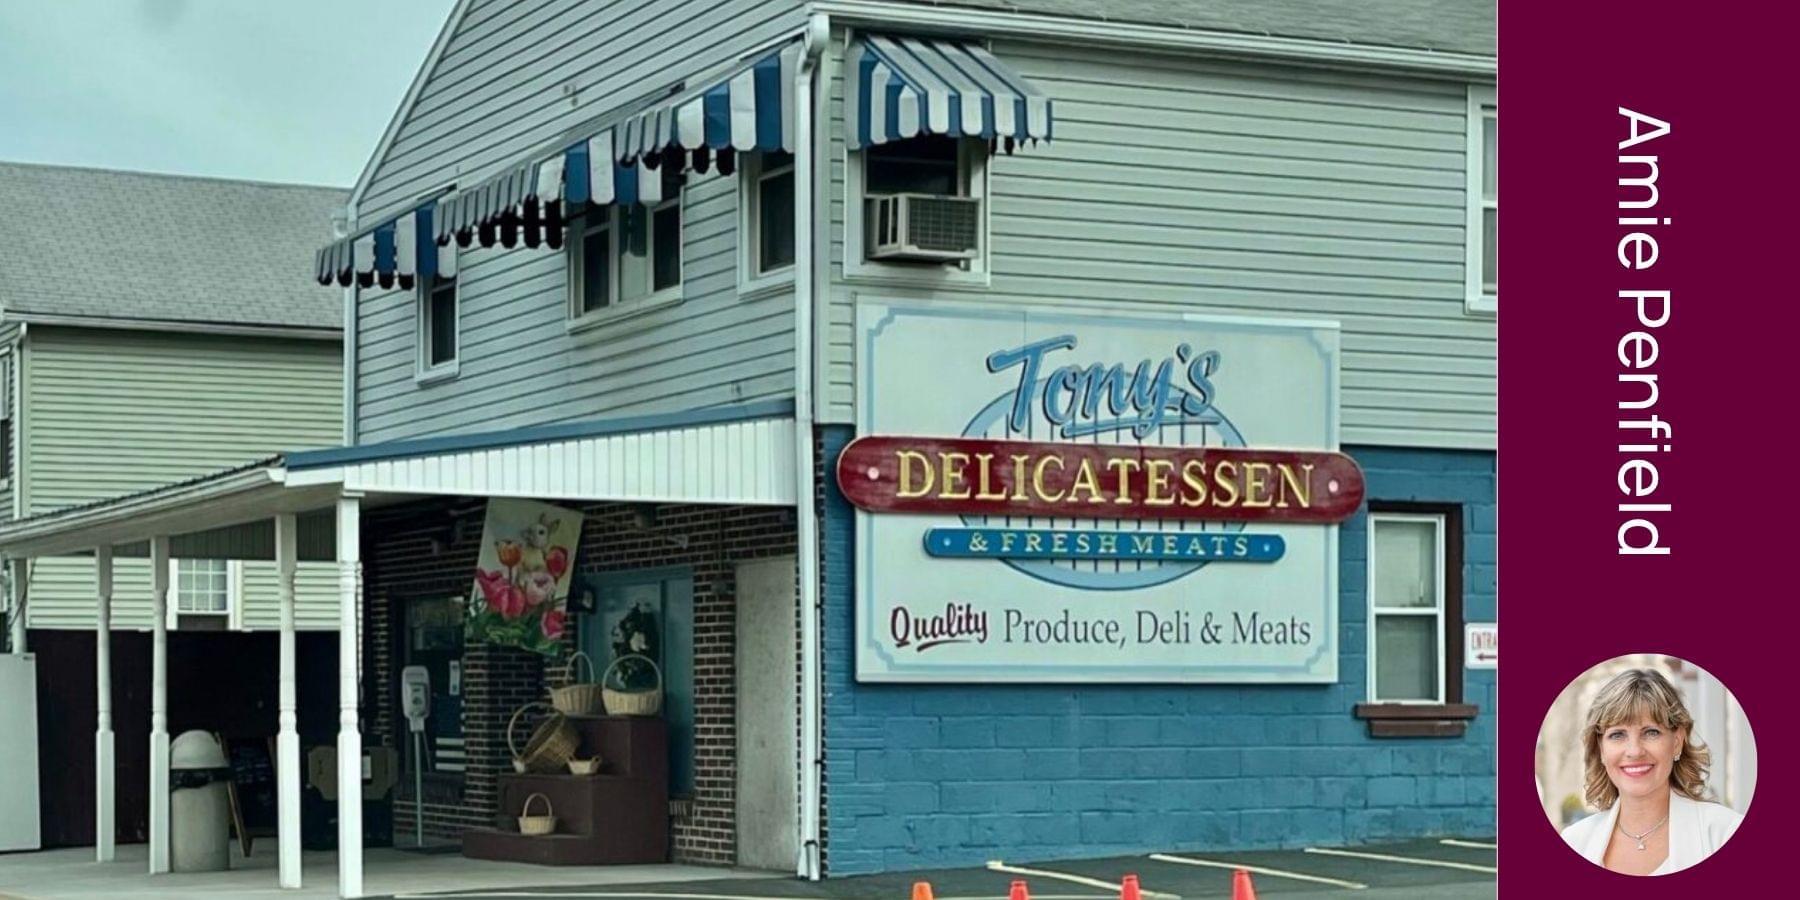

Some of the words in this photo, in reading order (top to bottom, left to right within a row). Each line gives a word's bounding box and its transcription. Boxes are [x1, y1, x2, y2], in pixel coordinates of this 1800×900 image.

[986, 335, 1220, 437] Tony's
[896, 450, 1315, 509] DELICATESSEN
[969, 532, 988, 552] &
[1000, 533, 1118, 555] FRESH
[1131, 535, 1249, 557] MEATS
[890, 603, 988, 652] Quality
[1004, 609, 1127, 650] Produce,
[1136, 610, 1190, 645] Deli
[1200, 611, 1223, 645] &
[1231, 611, 1311, 646] Meats
